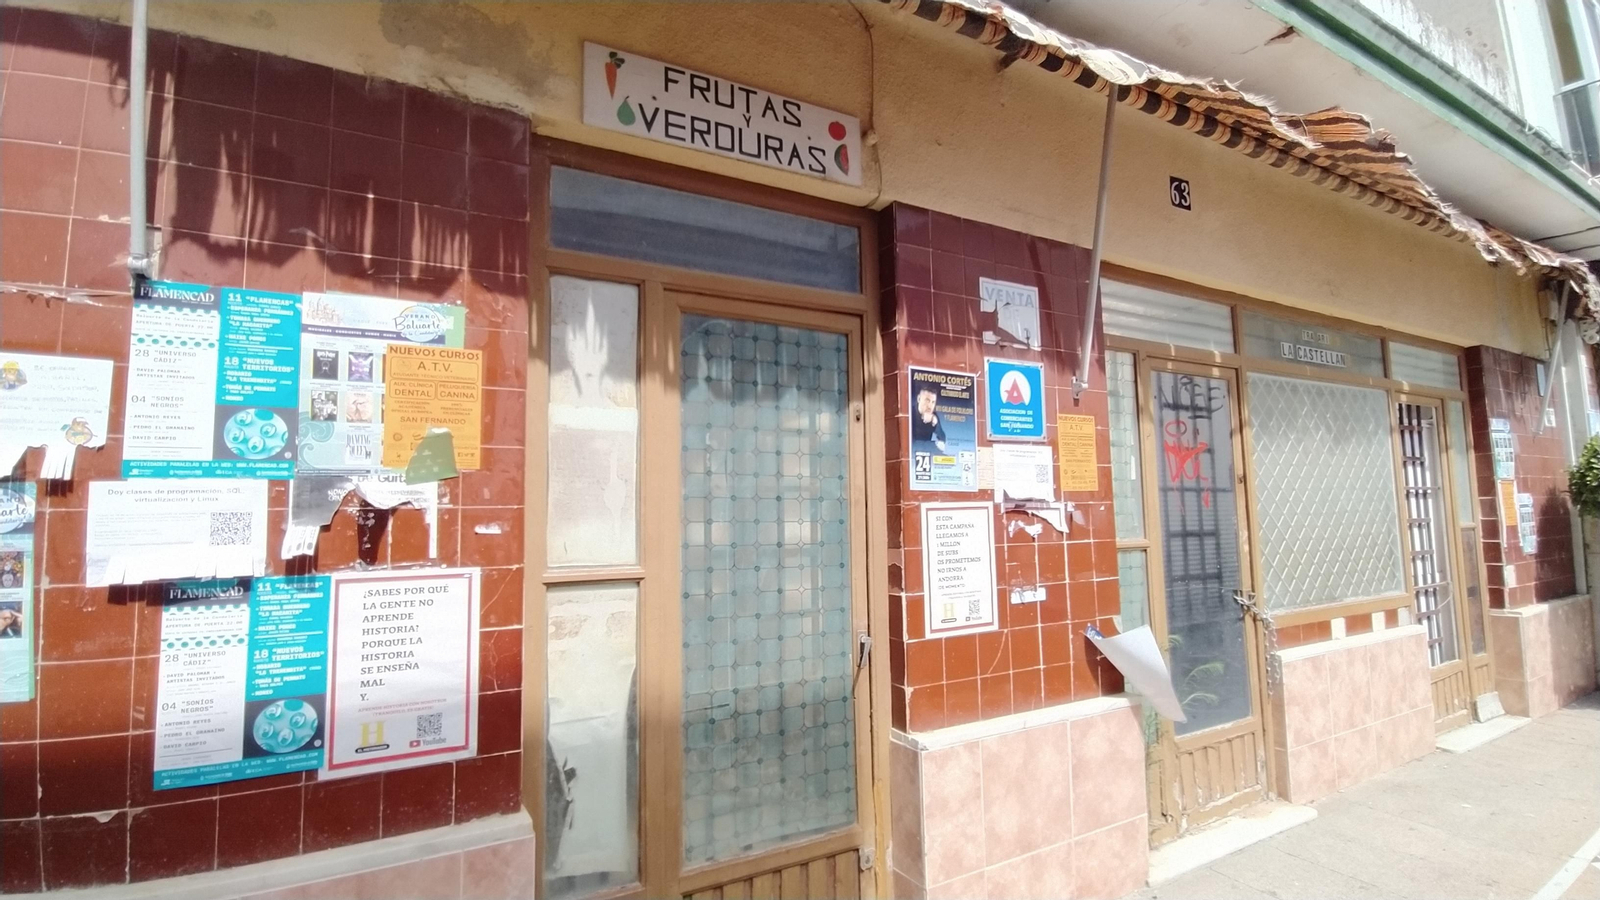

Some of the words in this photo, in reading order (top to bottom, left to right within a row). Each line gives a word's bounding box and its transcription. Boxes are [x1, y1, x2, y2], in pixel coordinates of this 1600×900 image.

[664, 66, 802, 127] FRUTAS
[742, 113, 752, 128] Y
[638, 103, 827, 175] VERDURAS
[1171, 181, 1190, 206] 63
[140, 287, 215, 303] FLAMENCAD
[228, 292, 242, 303] 11
[985, 287, 1034, 308] VENTA
[392, 316, 440, 331] Baluarte
[134, 348, 150, 358] 28
[389, 346, 436, 357] NUEVOS
[439, 349, 480, 361] CURSOS
[1281, 343, 1293, 357] LA
[1297, 346, 1346, 366] CASTELLAN
[224, 356, 239, 366] 18
[417, 361, 453, 373] A.T.V.
[913, 371, 946, 384] ANTONIO
[947, 376, 972, 387] CORTÉS
[394, 388, 432, 397] DENTAL
[439, 390, 475, 399] CANINA
[131, 395, 146, 404] 04
[420, 417, 466, 425] FERNANDO
[915, 456, 930, 472] 24
[169, 586, 244, 599] FLAMENCAD
[257, 582, 272, 592] 11
[363, 588, 401, 599] ¿SABES
[404, 586, 425, 596] POR
[427, 584, 449, 594] QUÉ
[363, 602, 377, 611] LA
[379, 600, 416, 610] GENTE
[418, 599, 434, 607] NO
[362, 612, 414, 624] APRENDE
[361, 625, 420, 637] HISTORIA?
[361, 638, 407, 650] PORQUE
[409, 637, 423, 645] LA
[164, 654, 180, 663] 28
[184, 650, 226, 659] "UNIVERSO
[253, 649, 269, 659] 18
[361, 650, 415, 663] HISTORIA
[360, 667, 374, 676] SE
[376, 661, 420, 674] ENSEÑA
[359, 678, 386, 689] MAL
[359, 693, 370, 702] Y.
[161, 702, 177, 711] 04
[180, 706, 213, 714] NEGROS"
[359, 720, 385, 748] H
[184, 740, 207, 748] CARPIO
[422, 737, 447, 746] YouTube
[161, 768, 198, 777] ACTIVIDADES
